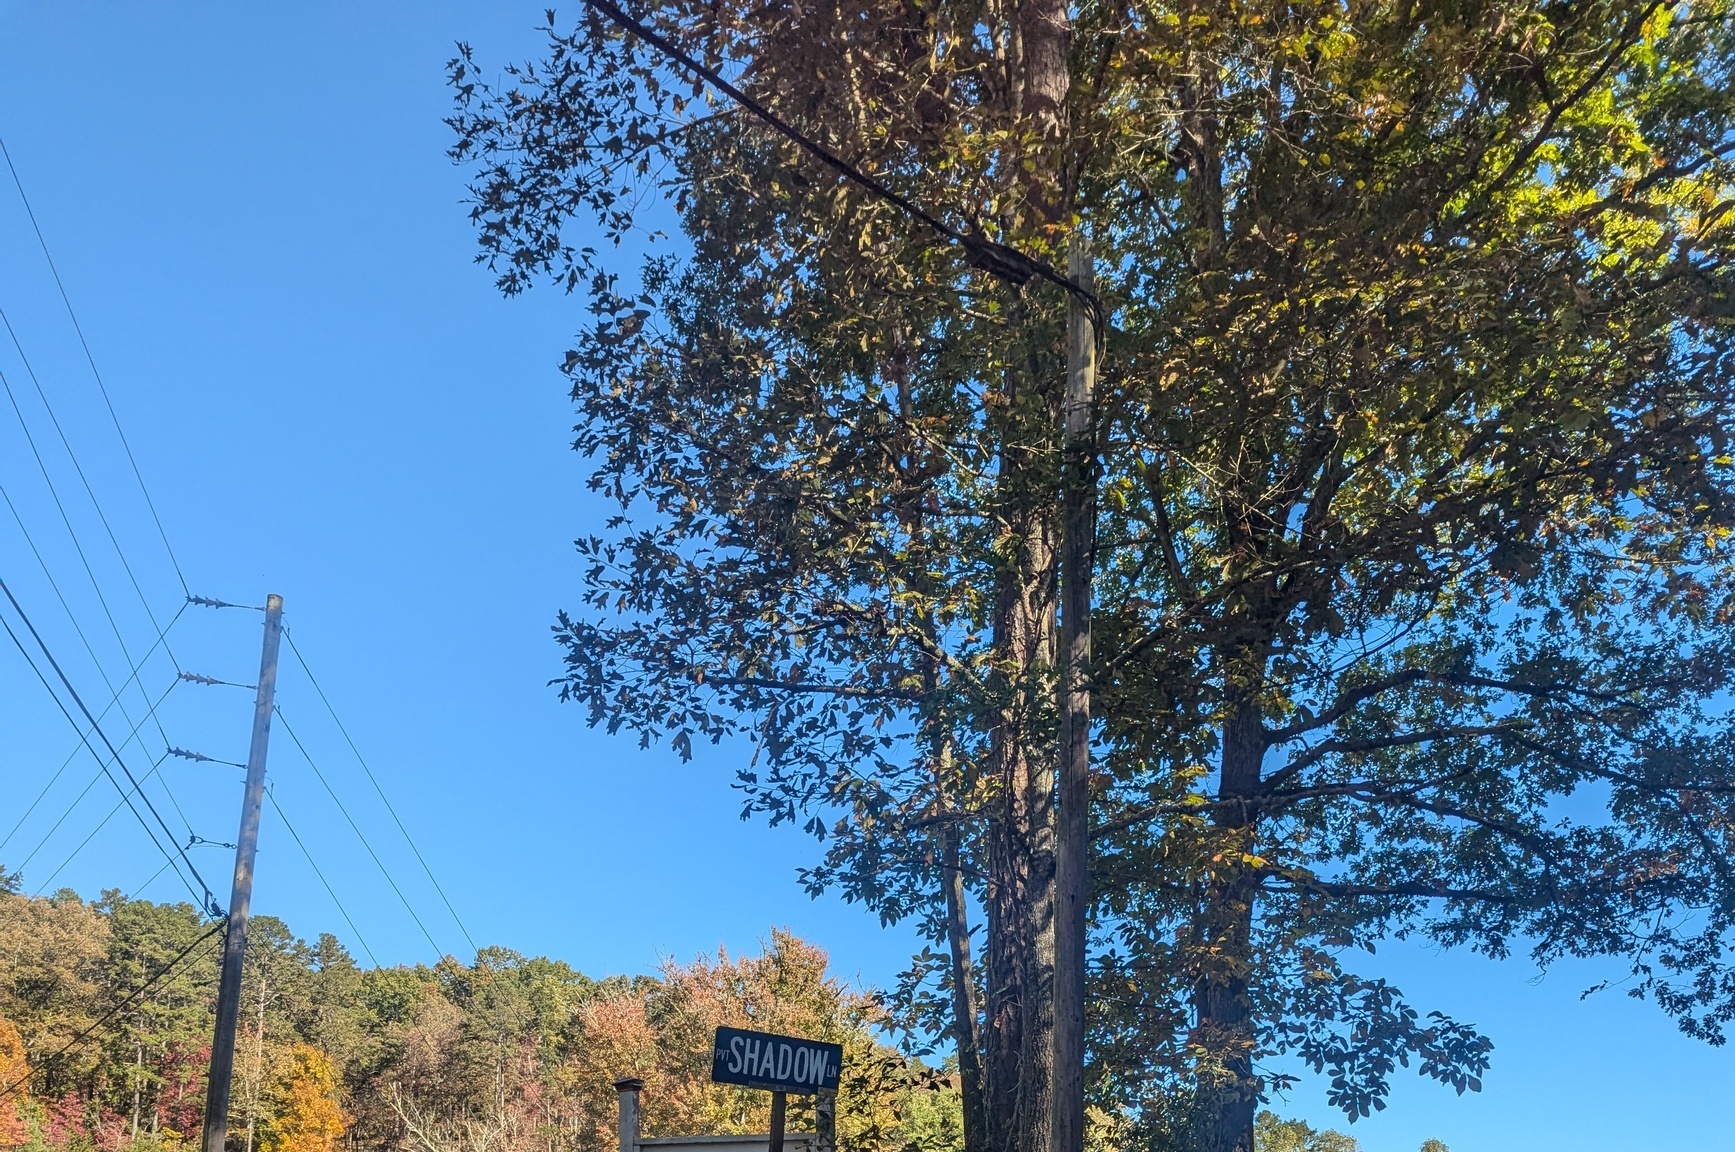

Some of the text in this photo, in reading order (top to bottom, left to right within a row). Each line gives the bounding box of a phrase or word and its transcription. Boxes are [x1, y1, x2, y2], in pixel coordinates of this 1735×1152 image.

[716, 1036, 837, 1085] PVT SHADOW LN
